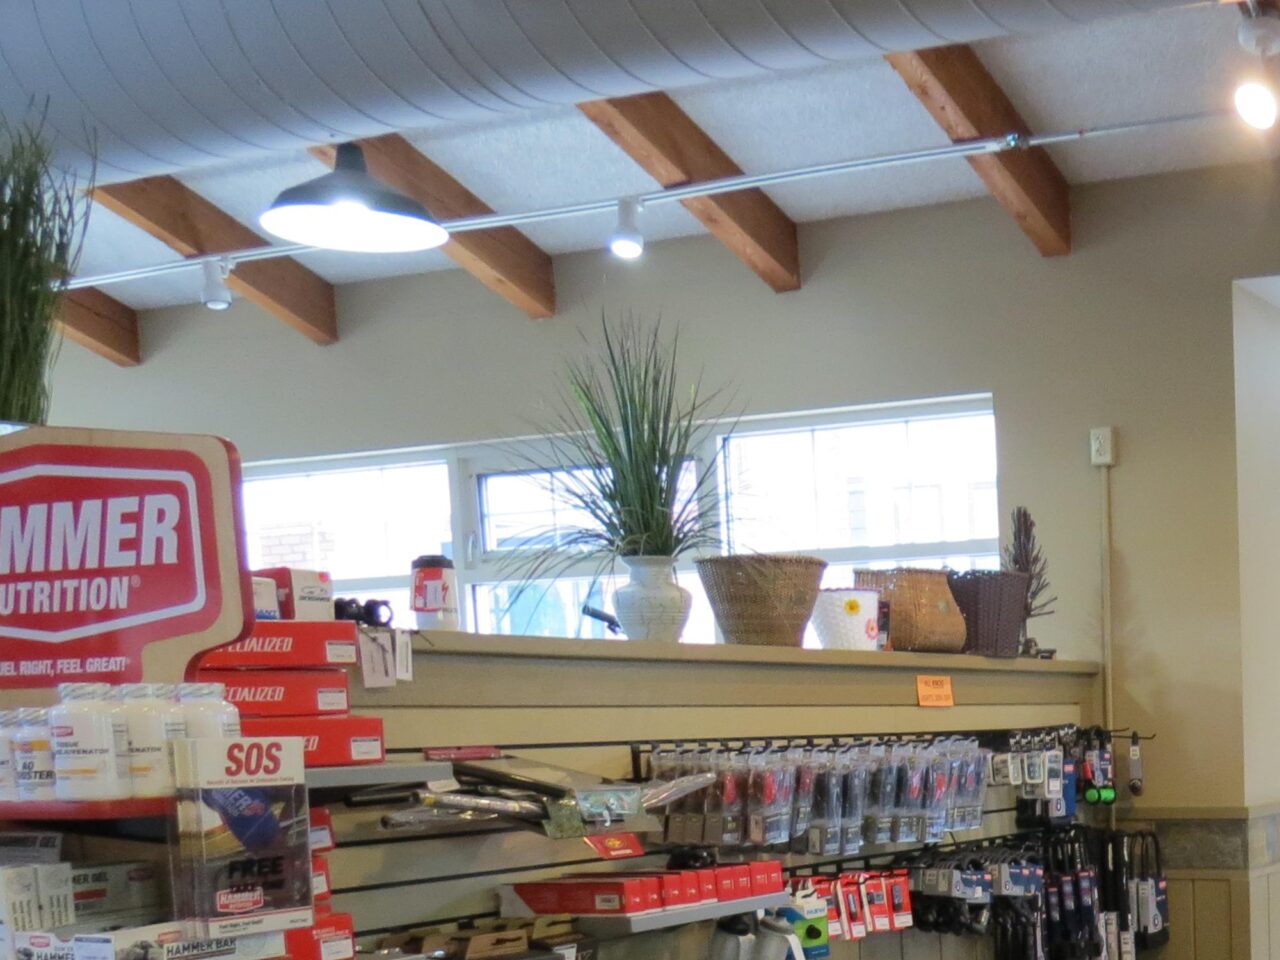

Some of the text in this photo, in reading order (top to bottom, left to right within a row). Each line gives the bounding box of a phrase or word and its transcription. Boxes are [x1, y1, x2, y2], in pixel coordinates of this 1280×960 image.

[218, 637, 293, 652] CIALIZED
[19, 660, 53, 677] RIGHT,
[56, 659, 82, 673] FEEL
[86, 656, 125, 672] GREAT!
[225, 742, 283, 776] SOS
